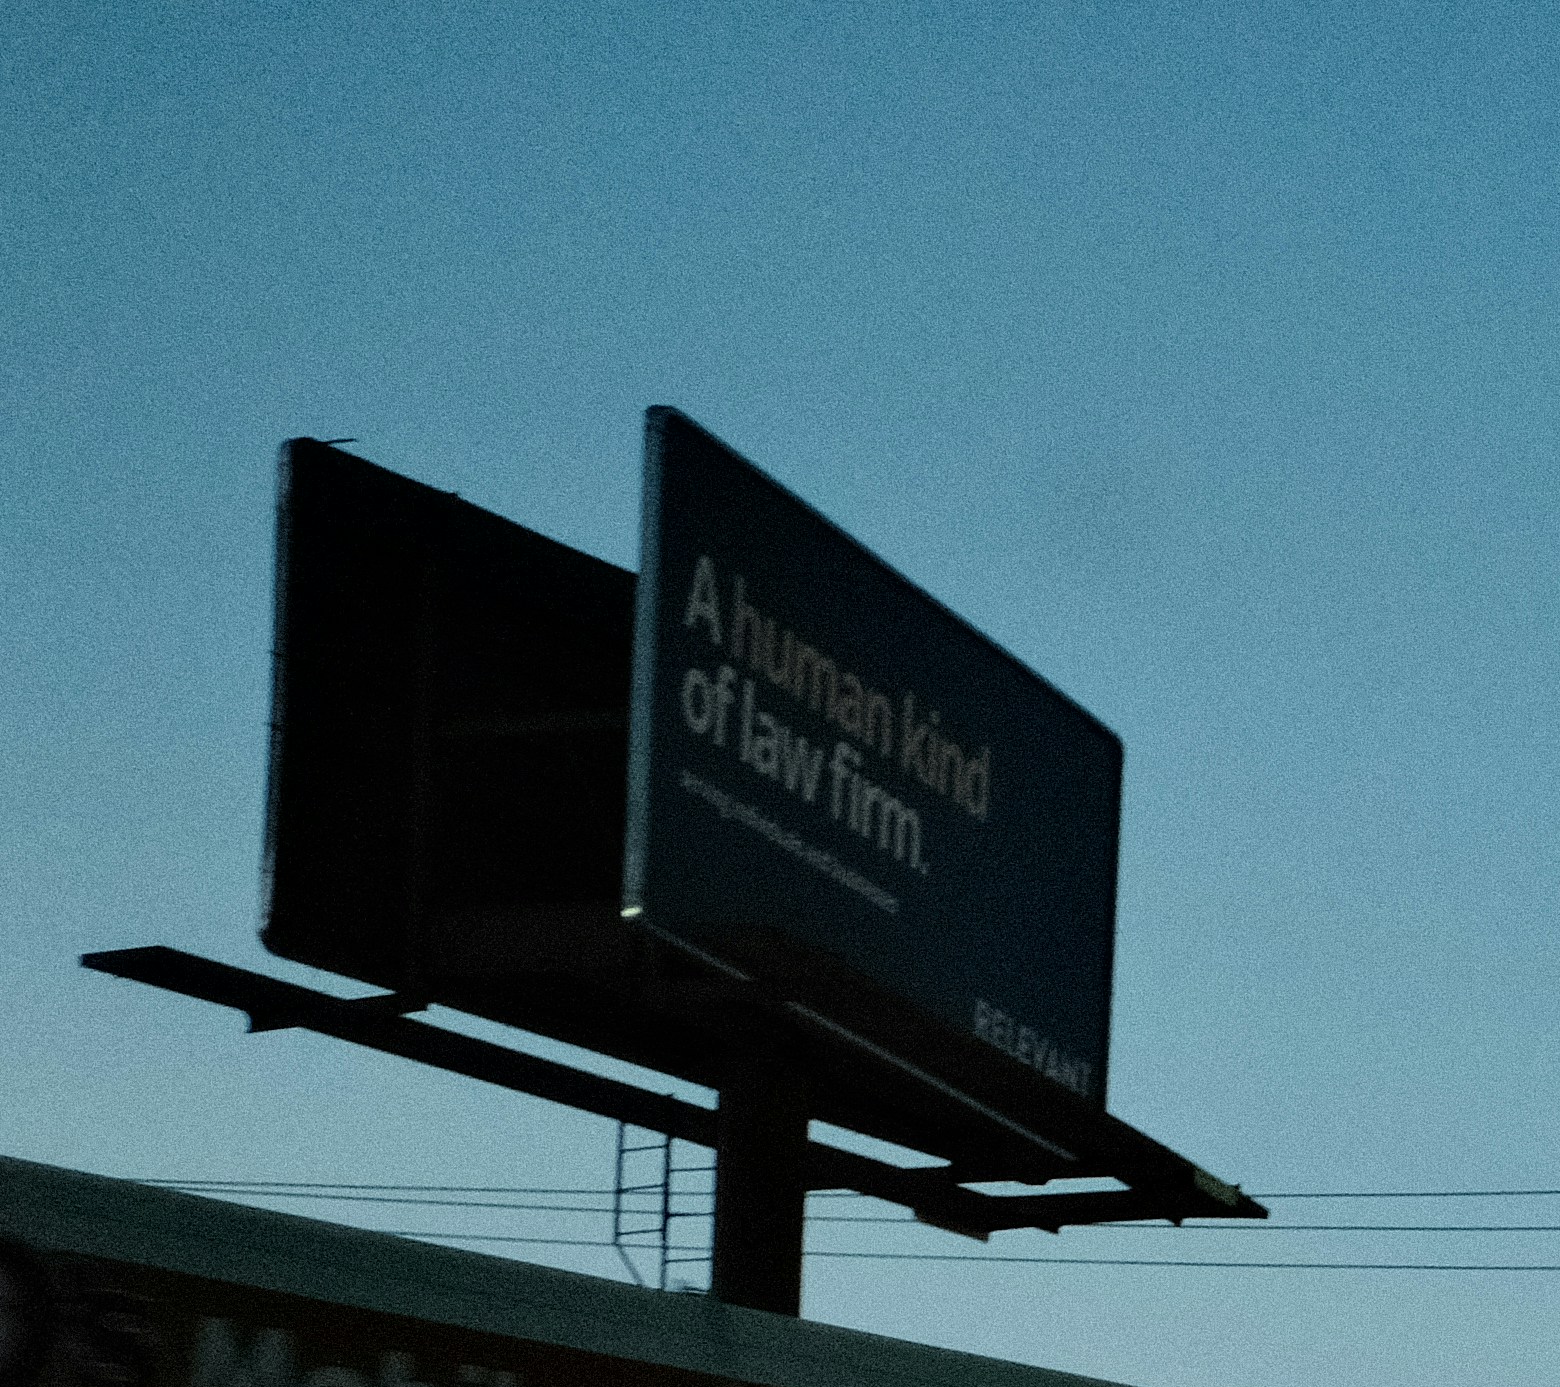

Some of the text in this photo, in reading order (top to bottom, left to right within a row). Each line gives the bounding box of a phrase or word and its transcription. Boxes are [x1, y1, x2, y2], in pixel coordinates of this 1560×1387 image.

[679, 662, 737, 748] of
[739, 678, 823, 806] law
[828, 739, 931, 876] firm.
[683, 553, 993, 823] A human kind
[972, 997, 1093, 1098] RELEVANT
